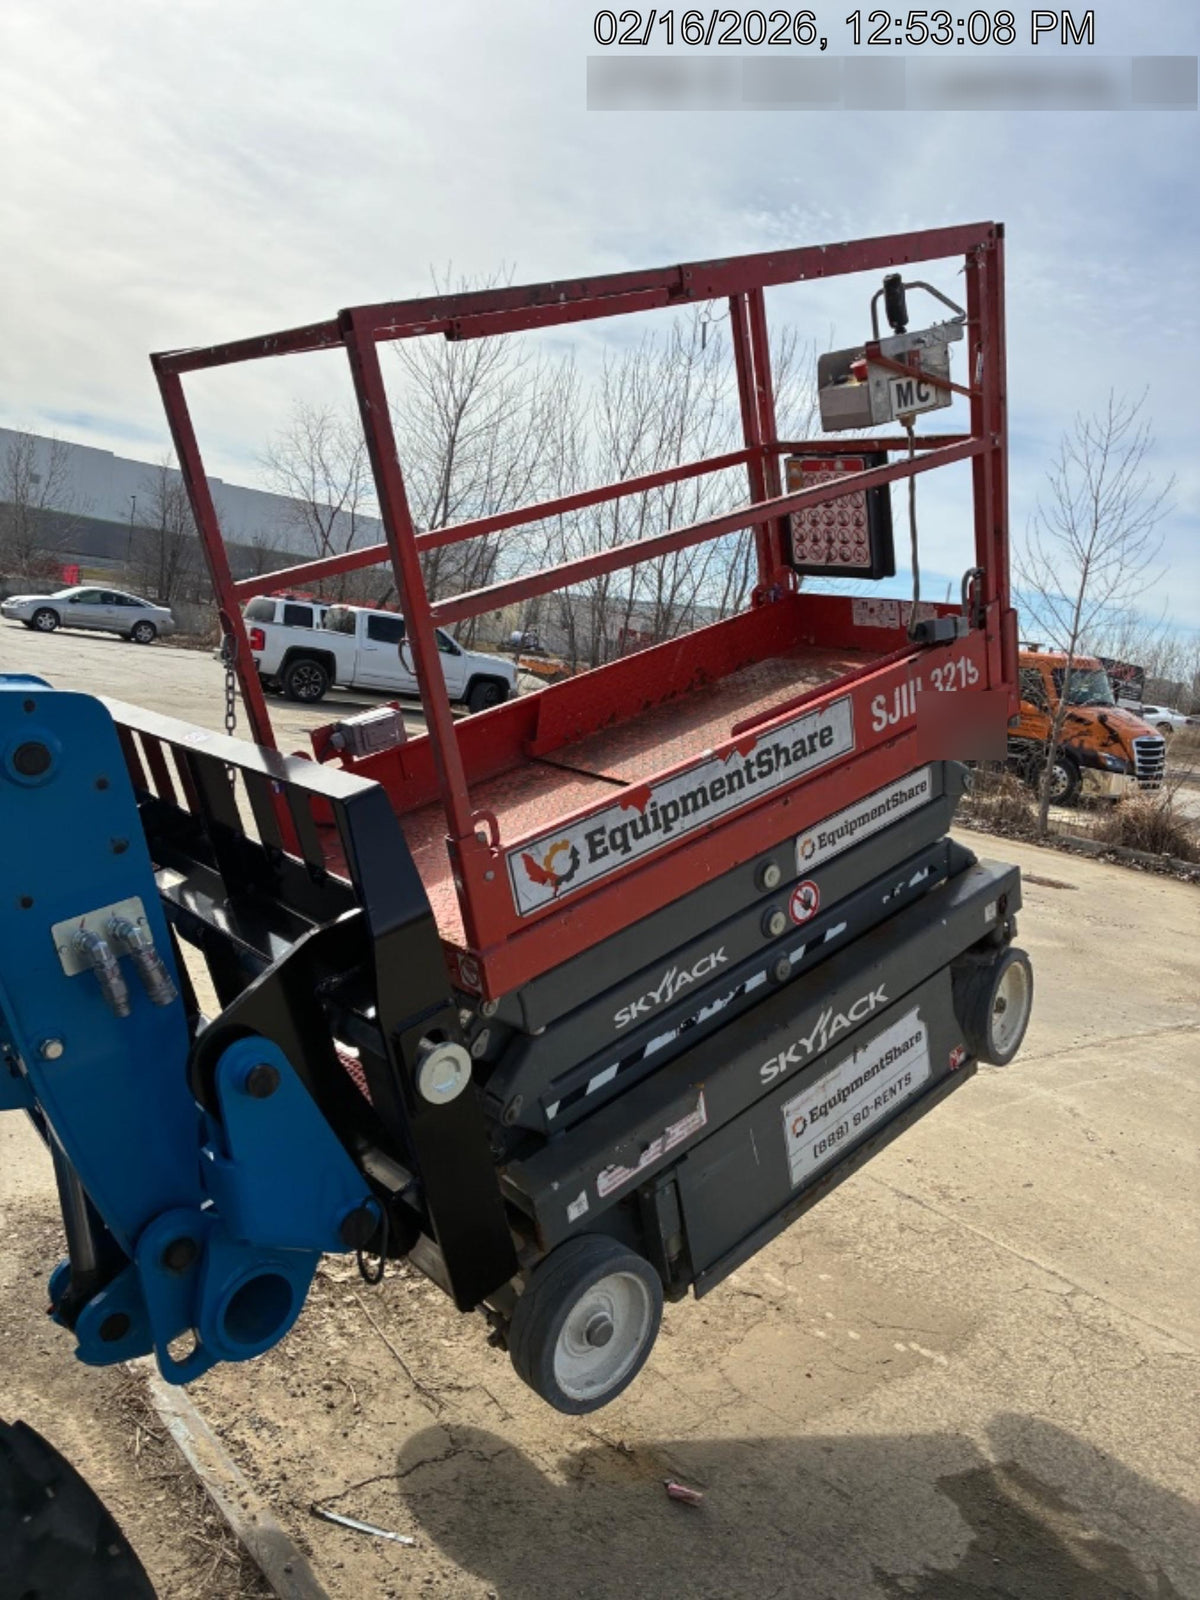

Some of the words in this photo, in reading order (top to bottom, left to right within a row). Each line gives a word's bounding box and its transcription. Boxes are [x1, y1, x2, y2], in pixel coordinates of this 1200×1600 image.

[895, 380, 930, 409] MC
[584, 725, 834, 863] EquipmentShare
[816, 780, 928, 850] EquipmentShare
[613, 946, 729, 1029] SKYJACK
[759, 983, 889, 1084] SKYJACK
[808, 1030, 923, 1125] EquipmentShare
[813, 1121, 849, 1158] (888)
[852, 1072, 912, 1127] 80-RENTS
